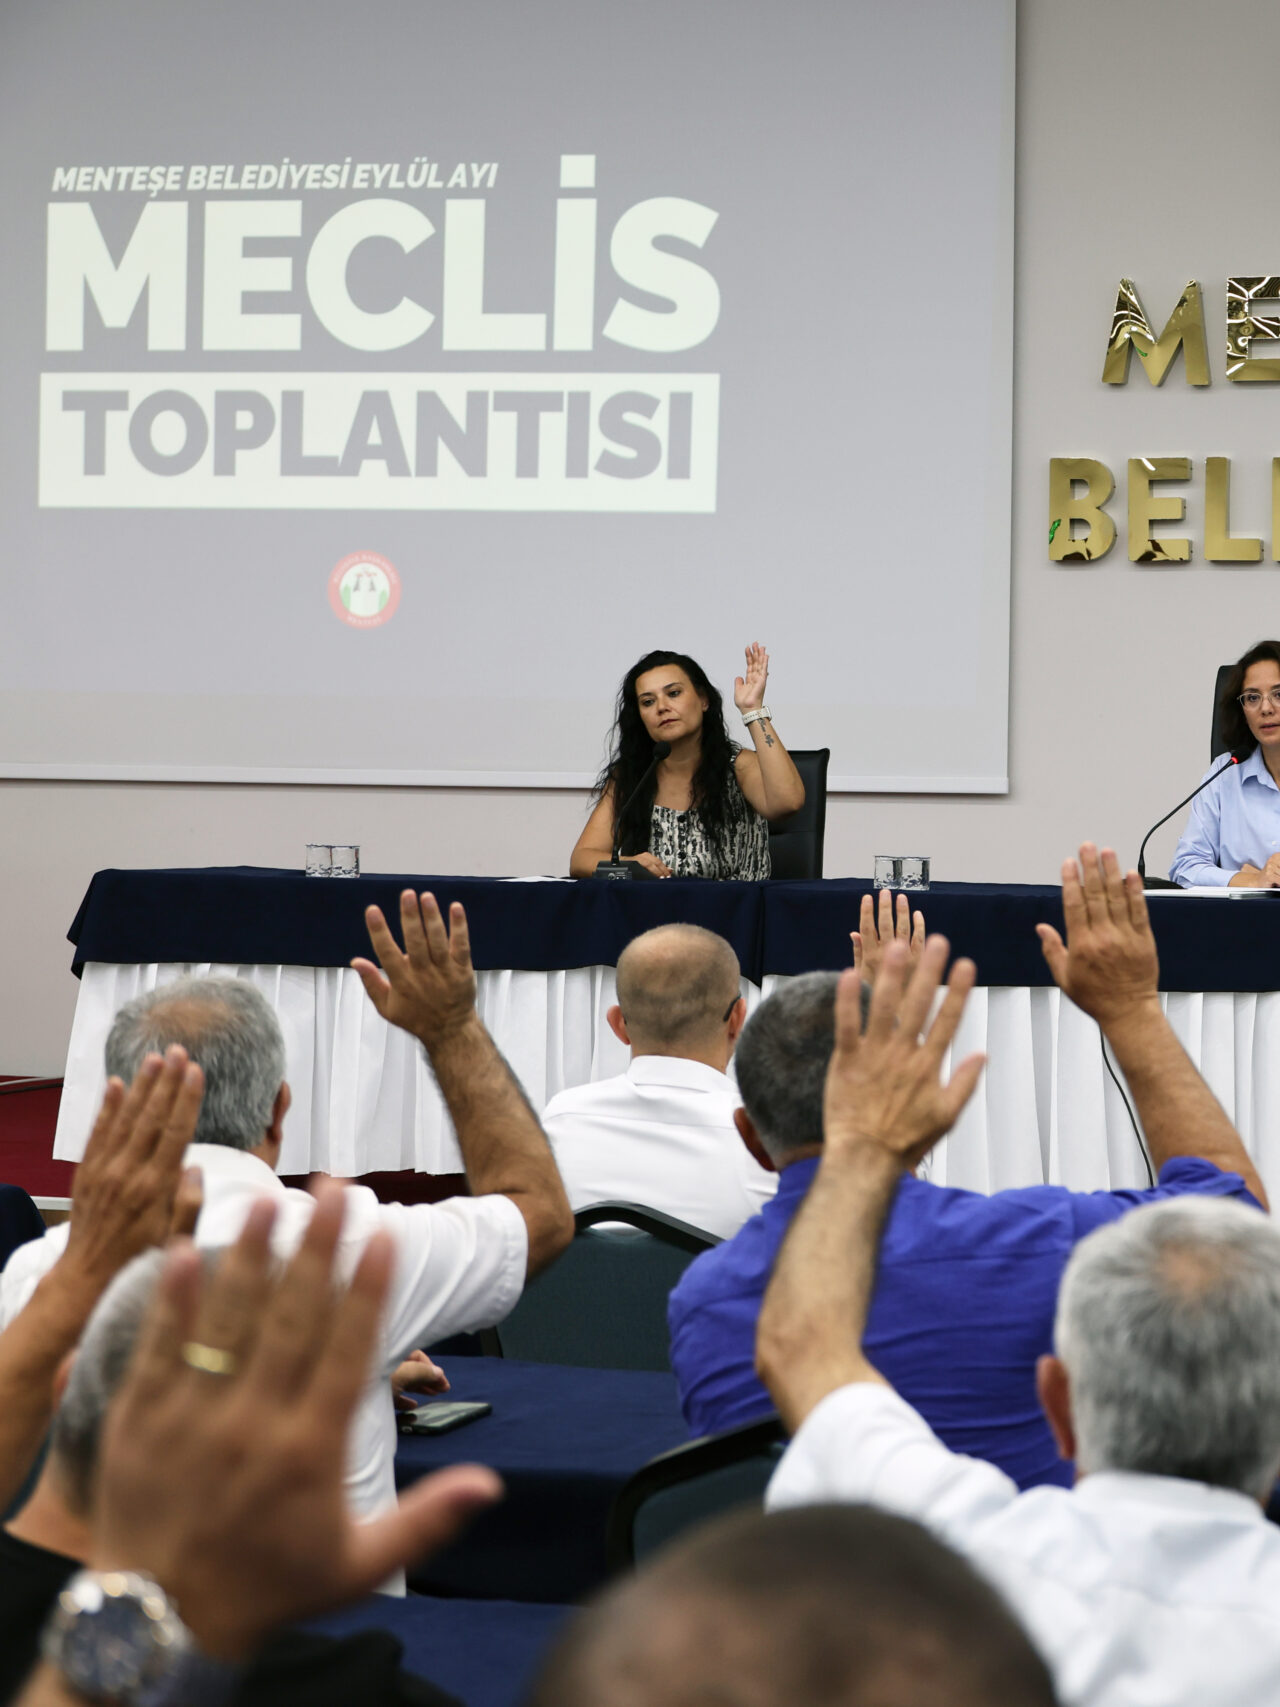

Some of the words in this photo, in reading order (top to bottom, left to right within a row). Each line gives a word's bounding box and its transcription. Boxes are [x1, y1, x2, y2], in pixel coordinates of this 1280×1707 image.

[52, 165, 186, 198] MENTEŞE
[186, 156, 352, 191] BELEDİYESİ
[351, 156, 444, 189] EYLÜL
[446, 162, 499, 189] AYI
[45, 154, 721, 353] MECLİS
[61, 389, 694, 480] TOPLANTISI
